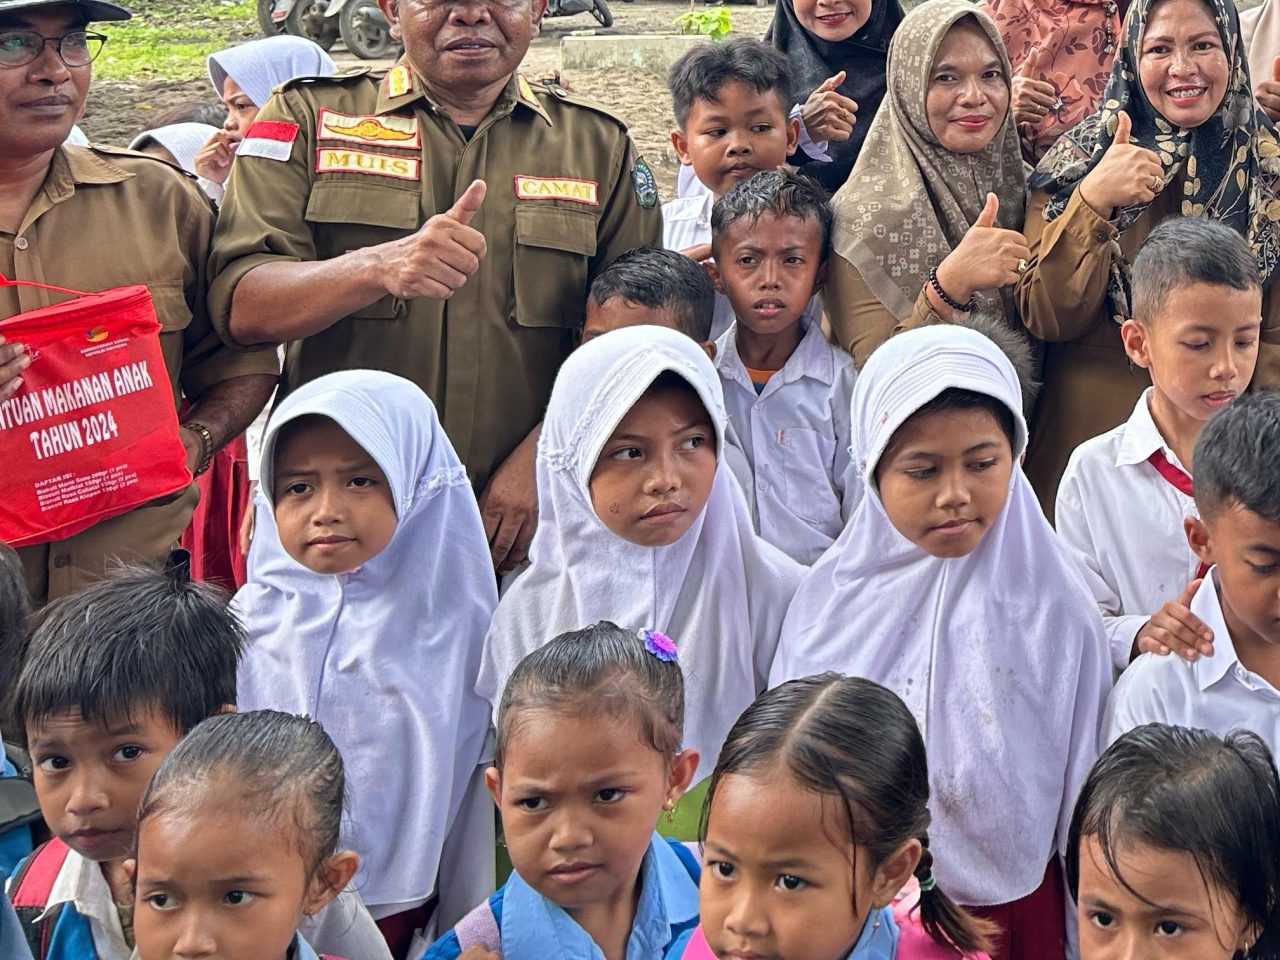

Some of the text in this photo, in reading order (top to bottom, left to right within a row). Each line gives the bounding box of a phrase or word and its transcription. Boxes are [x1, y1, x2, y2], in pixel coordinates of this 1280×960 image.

[326, 152, 409, 174] MUIS
[522, 181, 593, 199] CAMAT
[42, 371, 114, 417] MAKANAN
[113, 360, 153, 397] ANAK
[29, 410, 118, 460] TAHUN 2024
